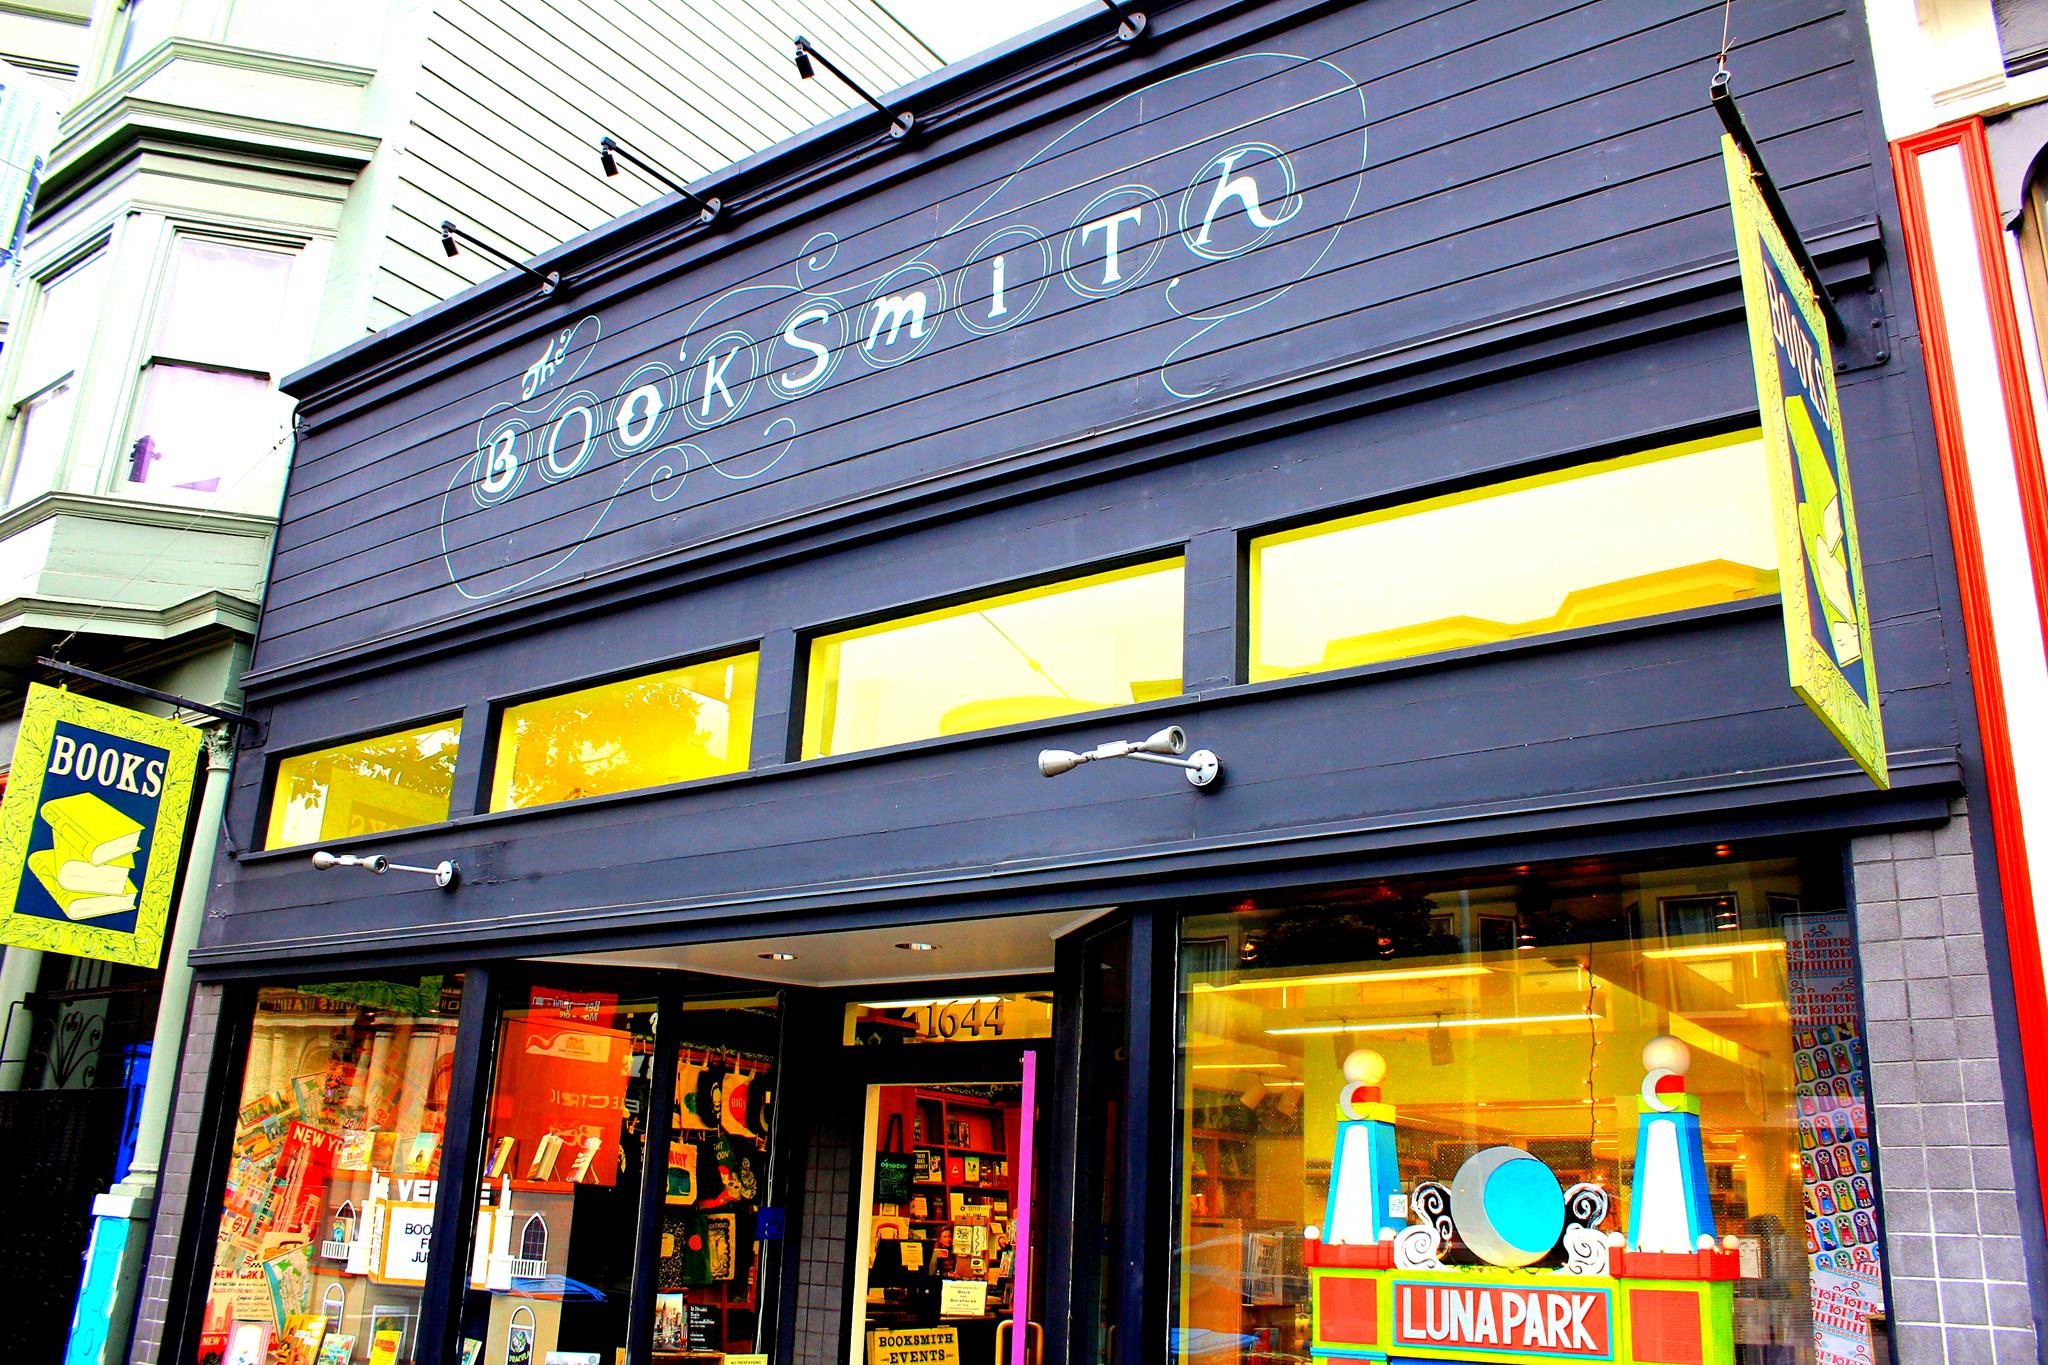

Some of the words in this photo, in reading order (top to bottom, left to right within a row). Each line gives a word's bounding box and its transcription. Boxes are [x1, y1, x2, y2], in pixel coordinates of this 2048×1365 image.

[1763, 260, 1832, 432] BOOKS
[521, 328, 573, 401] The
[48, 735, 165, 798] BOOKS
[926, 997, 1006, 1038] 1644
[293, 1125, 326, 1148] NEW
[327, 1136, 344, 1155] YO
[405, 1223, 433, 1236] BOO
[214, 1270, 234, 1280] NEW
[1403, 1287, 1499, 1345] LUNA
[1501, 1291, 1599, 1351] PARK
[202, 1336, 220, 1346] NEW
[879, 1333, 954, 1347] BOOKSMITH
[889, 1350, 945, 1364] EVENTS
